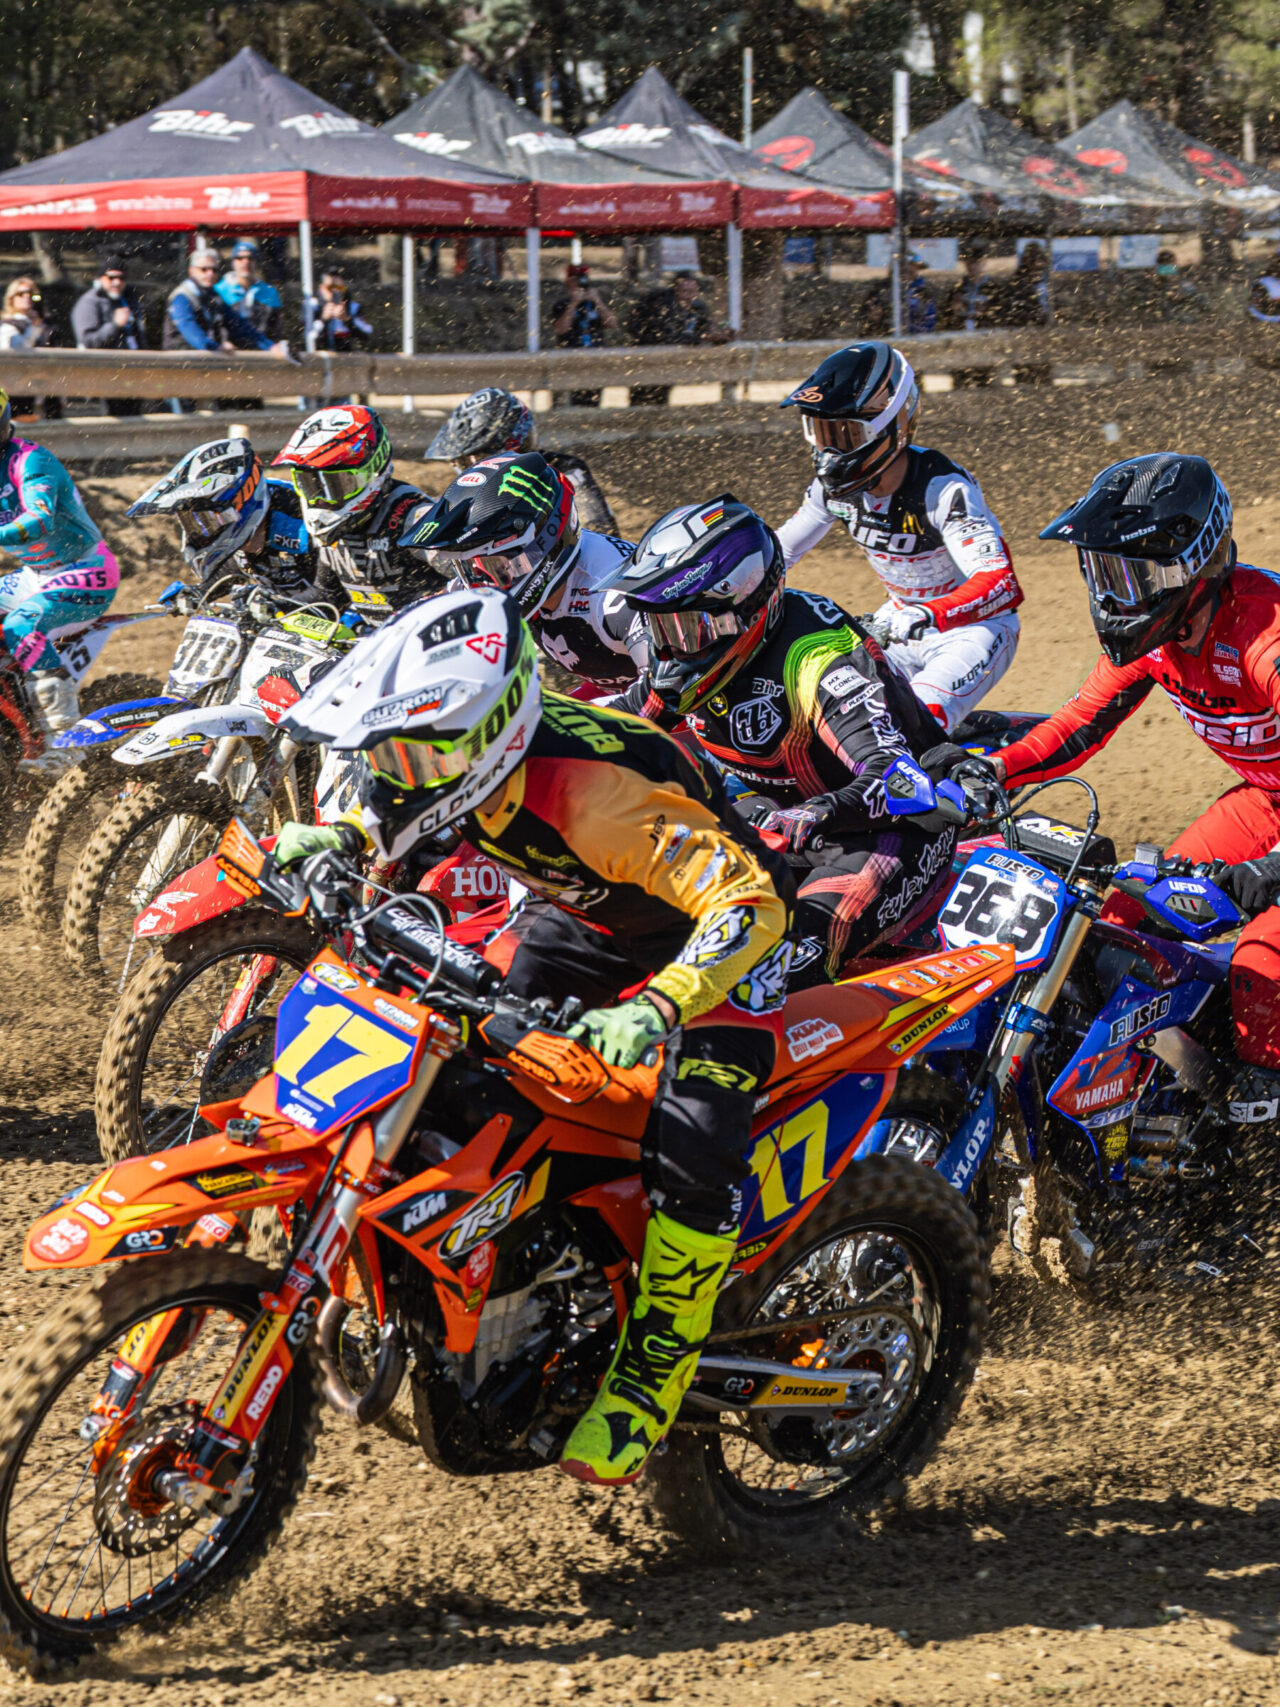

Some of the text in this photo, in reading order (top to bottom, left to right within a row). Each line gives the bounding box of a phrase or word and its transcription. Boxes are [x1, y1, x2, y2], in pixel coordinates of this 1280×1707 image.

[148, 109, 256, 137] Bihr
[461, 475, 481, 484] BELL
[272, 533, 301, 549] FXR
[536, 512, 566, 552] FOX
[321, 535, 404, 582] NEAL
[518, 560, 554, 606] MONSTER
[568, 601, 590, 612] HRC
[951, 631, 1005, 692] UFOPLAST
[752, 677, 785, 698] Bihr
[827, 675, 841, 686] MX
[896, 761, 925, 783] UFO
[420, 754, 506, 834] CLOVER
[451, 865, 510, 897] HON
[900, 1003, 951, 1045] DUNLOP
[273, 1003, 413, 1109] 17
[1075, 1078, 1124, 1110] YAMAHA
[281, 1103, 318, 1129] KTM
[748, 1098, 834, 1223] 17
[949, 1118, 988, 1190] NLOP
[402, 1192, 448, 1234] KTM
[780, 1384, 839, 1399] DUNLOP
